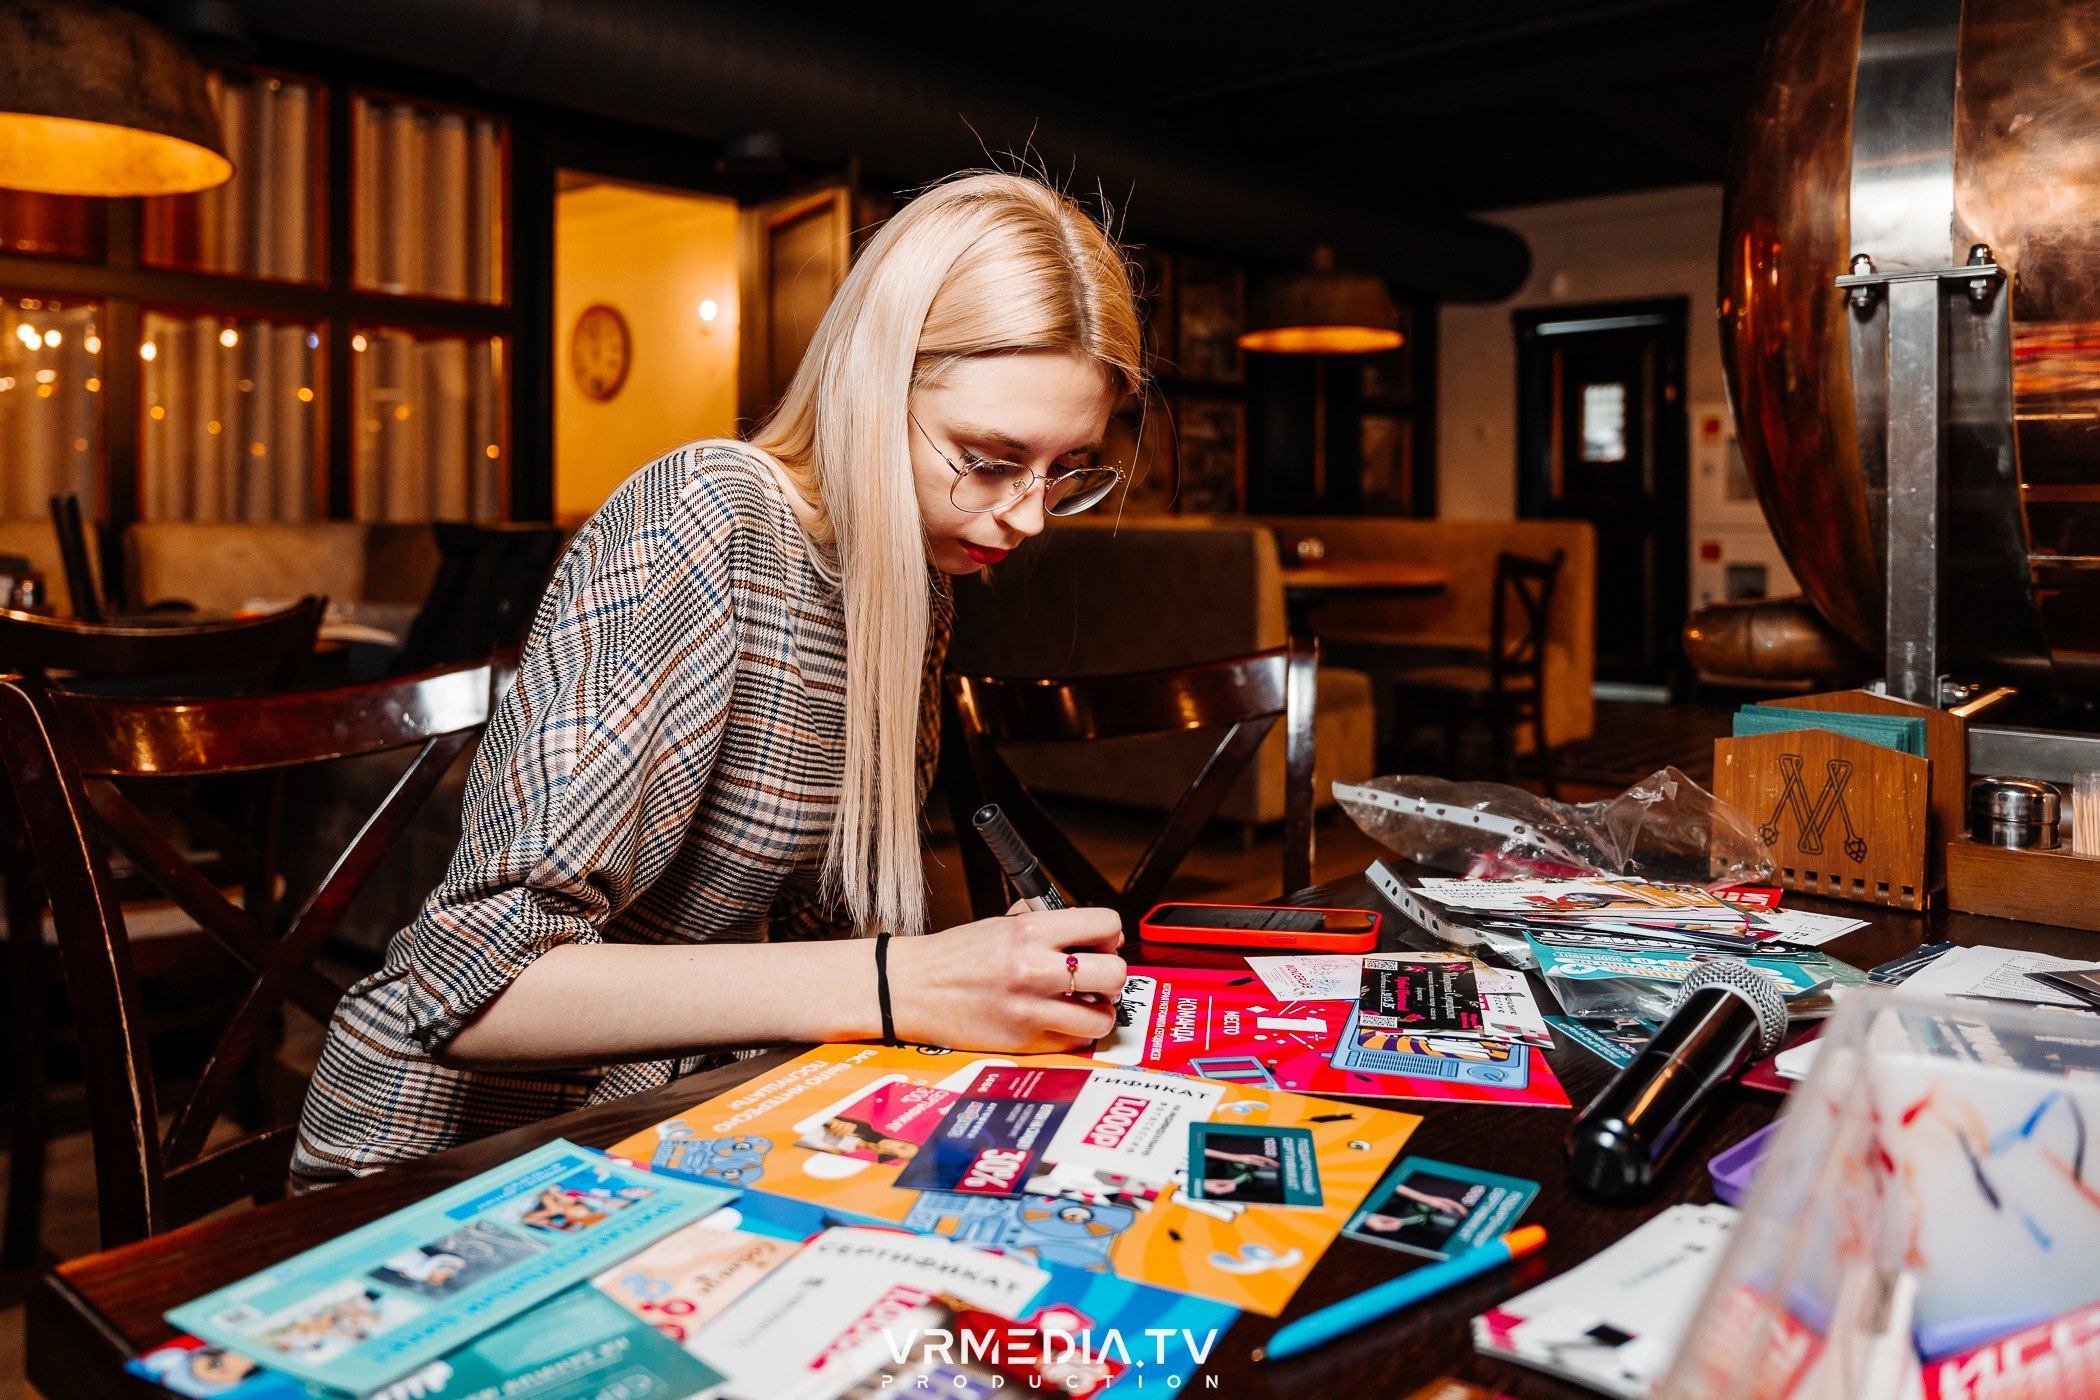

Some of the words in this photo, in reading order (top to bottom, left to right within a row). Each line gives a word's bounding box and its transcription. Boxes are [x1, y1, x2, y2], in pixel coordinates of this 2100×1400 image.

[1169, 997, 1198, 1043] КОМАНДА
[1222, 1010, 1241, 1036] МЕСТО
[845, 1049, 879, 1065] ВАС
[804, 1062, 854, 1087] БЫЛО
[1093, 1075, 1212, 1099] ТИФИКАТ
[711, 1084, 811, 1133] ИНТЕРЕСНО
[964, 1148, 1028, 1189] 30%
[817, 1239, 1025, 1294] СЕРТИФИКАТ
